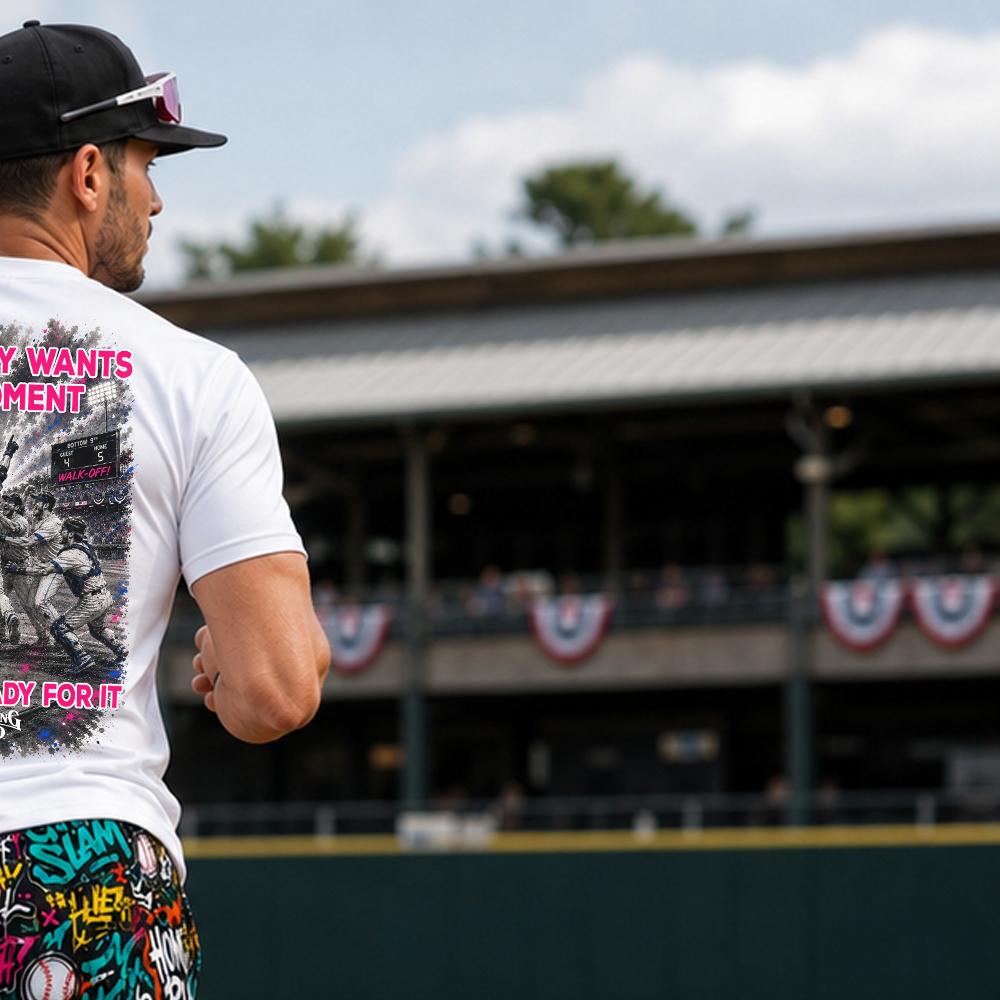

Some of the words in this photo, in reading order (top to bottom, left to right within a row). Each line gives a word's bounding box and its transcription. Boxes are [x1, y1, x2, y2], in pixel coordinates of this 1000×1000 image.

[26, 346, 134, 379] WANTS
[63, 458, 70, 467] 4
[97, 451, 104, 462] 5
[58, 466, 111, 482] WALK-OFF!
[42, 682, 93, 709] FOR
[99, 684, 123, 709] IT
[28, 818, 132, 885] SLAM
